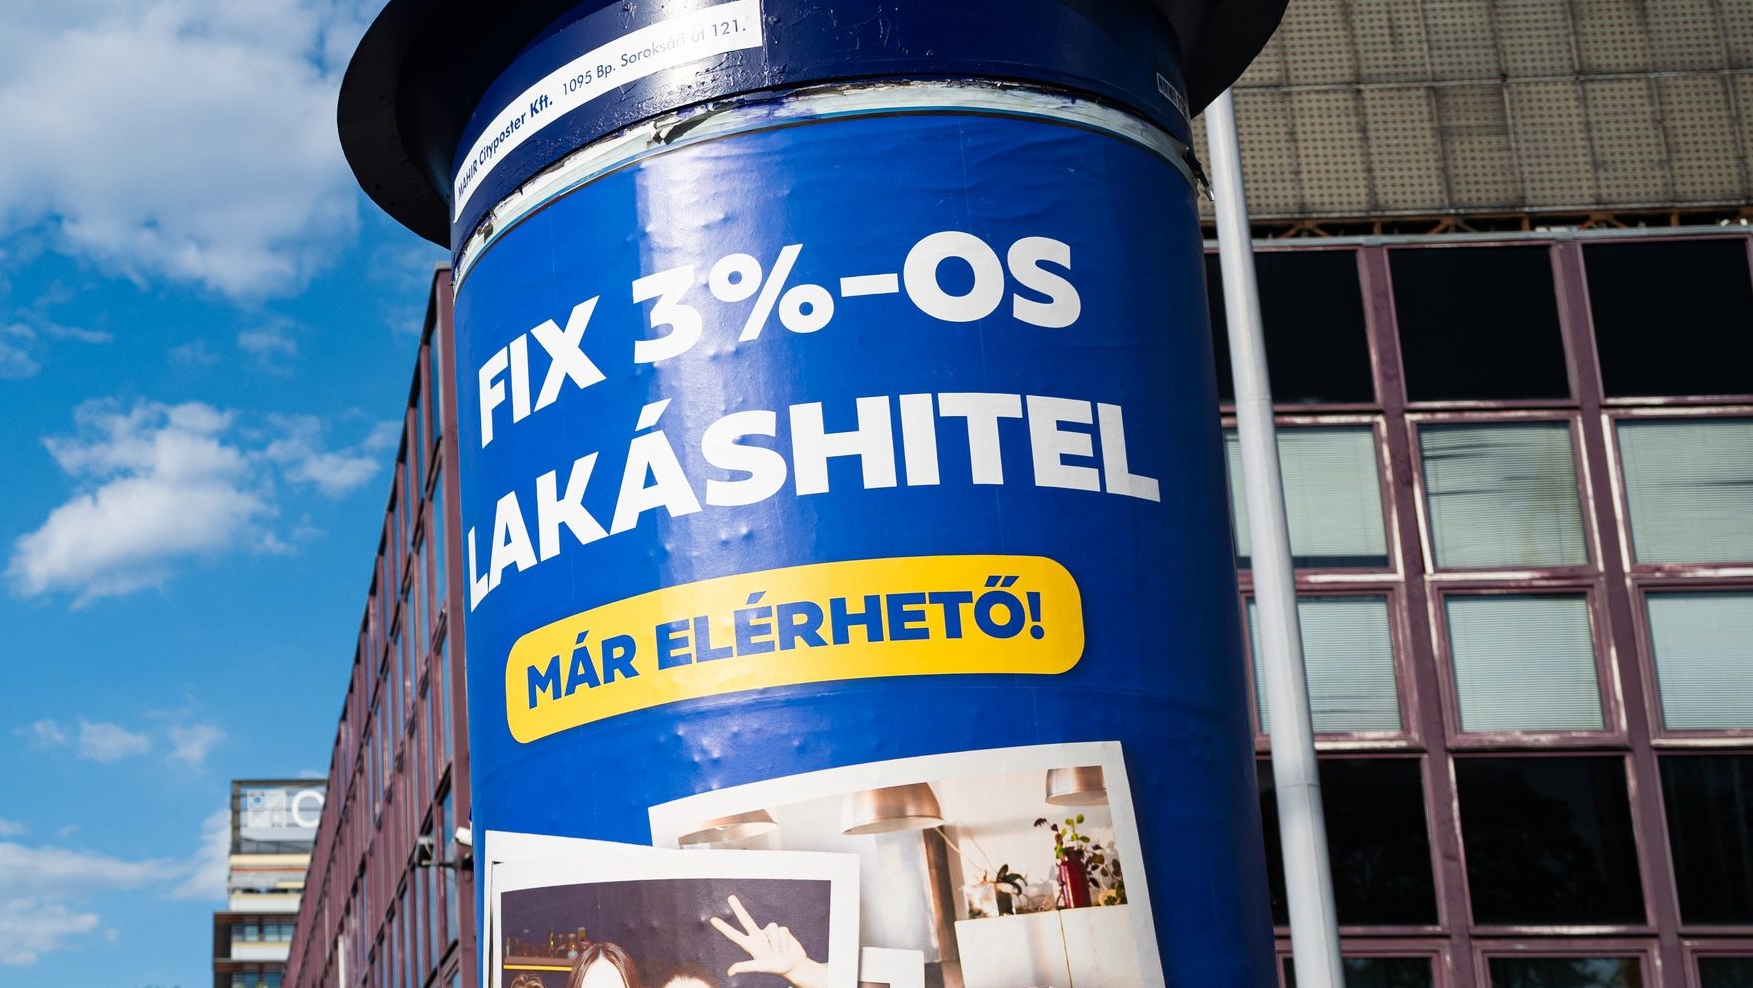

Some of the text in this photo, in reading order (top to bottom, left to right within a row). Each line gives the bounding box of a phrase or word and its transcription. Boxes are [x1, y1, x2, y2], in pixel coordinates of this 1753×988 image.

[458, 19, 746, 200] MAHIR Cityposter Kft. 1095 Bp. Soroksári út 121.
[479, 231, 1082, 448] FIX 3%-OS
[467, 392, 1161, 613] LAKÁSHITEL
[526, 575, 1046, 710] MÁR ELÉRHETŐ!
